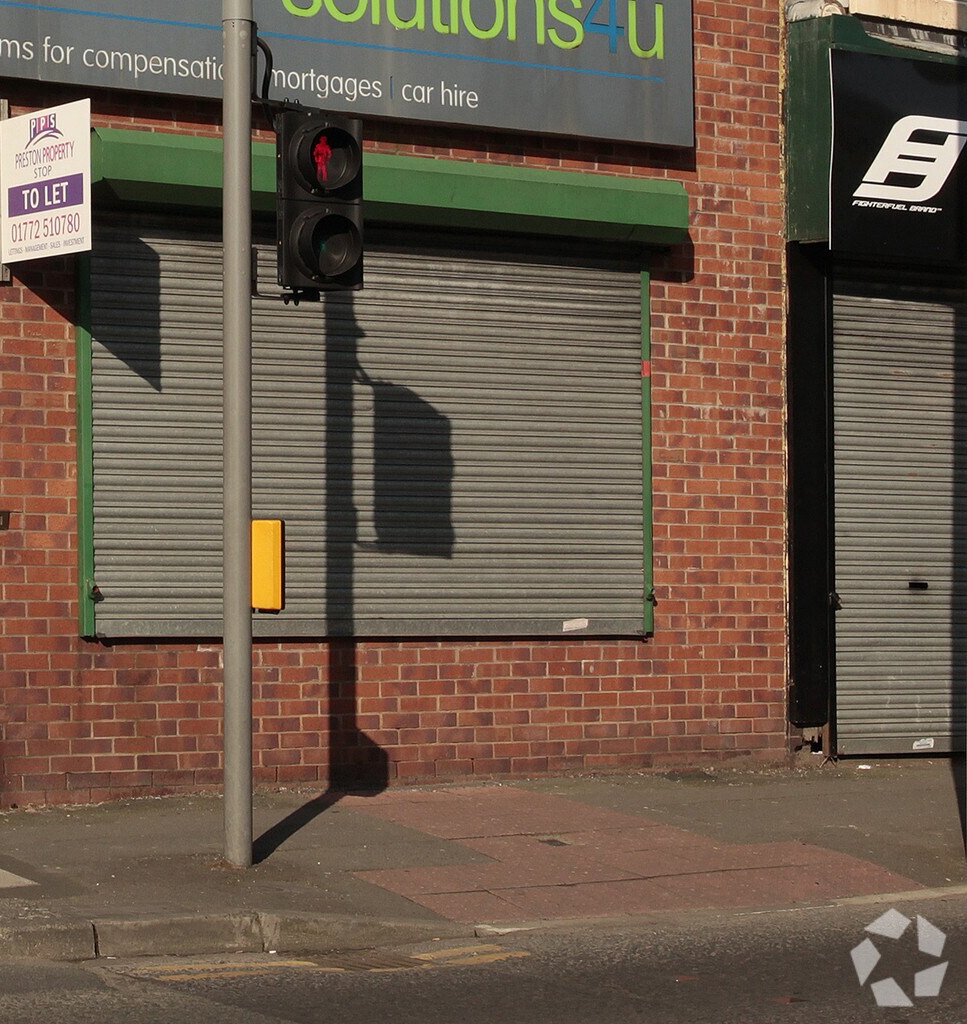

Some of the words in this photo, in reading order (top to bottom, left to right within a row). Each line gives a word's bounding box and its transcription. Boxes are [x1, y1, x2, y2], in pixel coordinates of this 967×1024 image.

[42, 36, 74, 65] for
[83, 47, 223, 80] compensati
[272, 68, 382, 102] mortgages
[401, 84, 434, 104] car
[441, 81, 479, 108] hire
[15, 149, 41, 169] PRESTON
[42, 141, 74, 164] PROPERTY
[34, 165, 52, 178] STOP
[22, 187, 39, 210] TO
[44, 181, 68, 207] LET
[852, 200, 908, 211] FIGHTERFUEL
[12, 219, 40, 243] 01772
[42, 212, 80, 238] 510780
